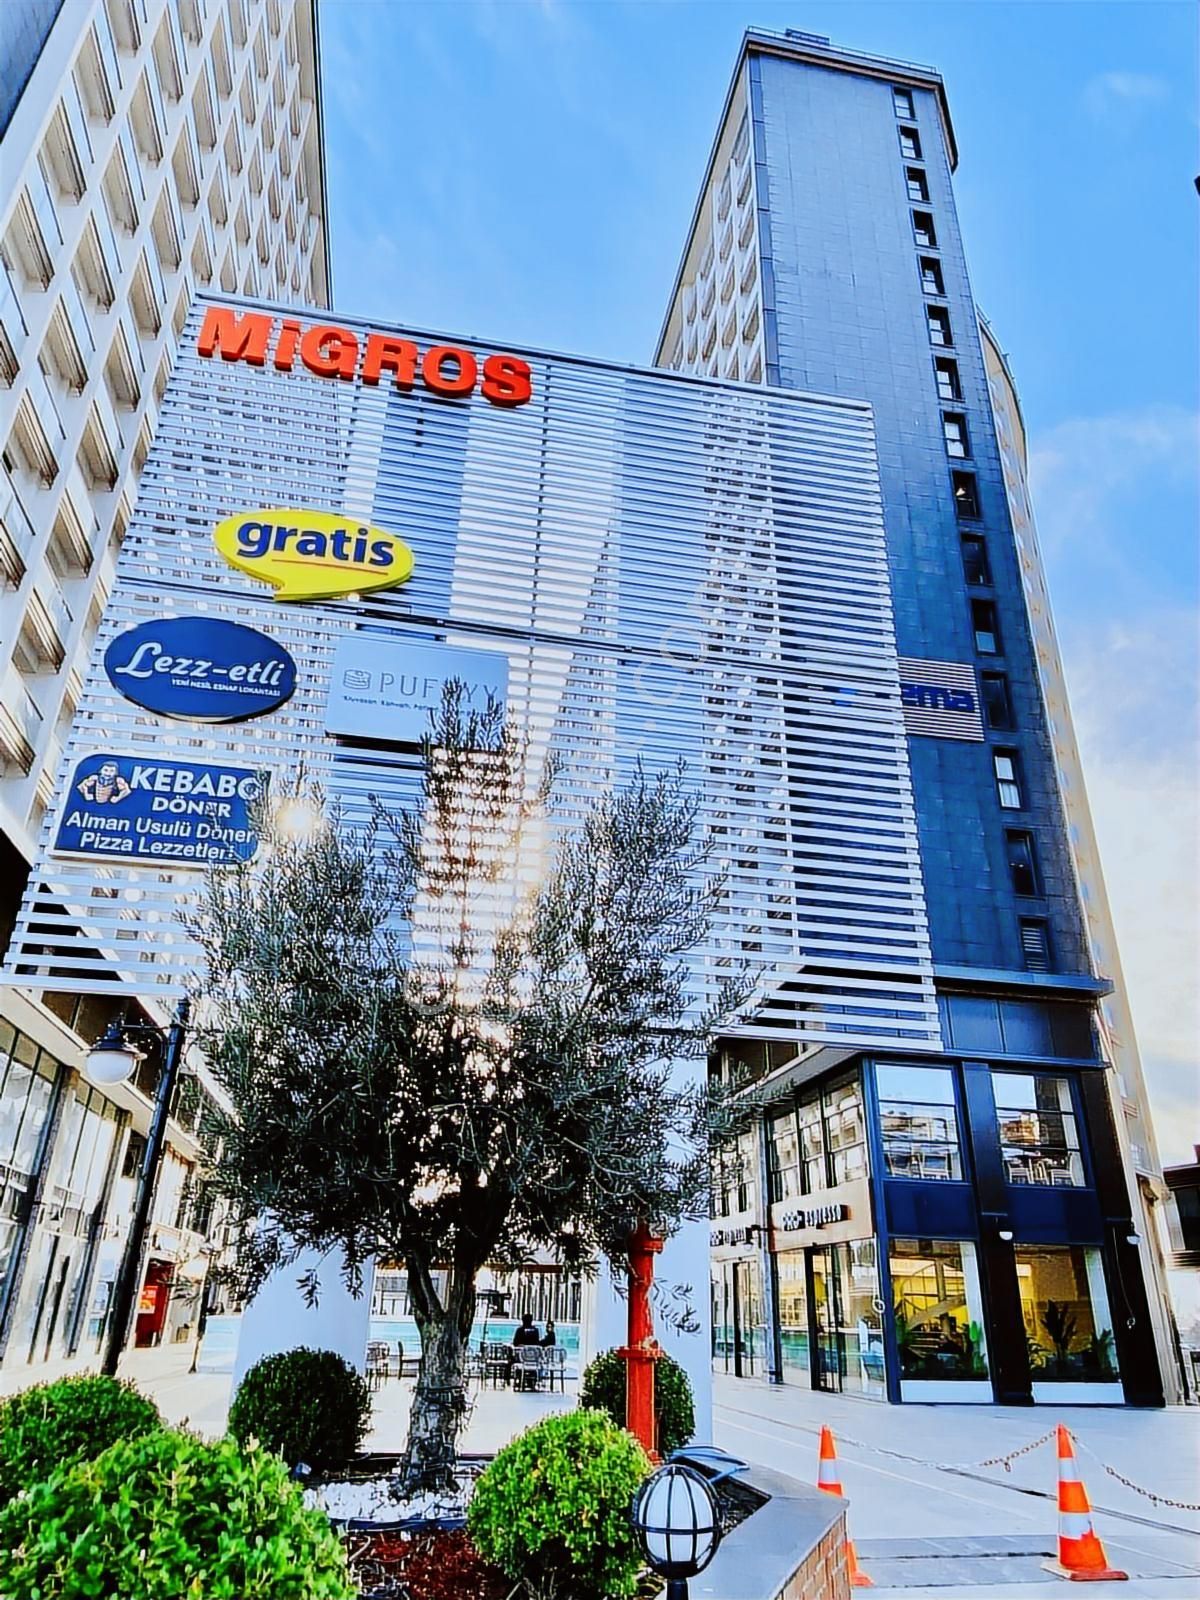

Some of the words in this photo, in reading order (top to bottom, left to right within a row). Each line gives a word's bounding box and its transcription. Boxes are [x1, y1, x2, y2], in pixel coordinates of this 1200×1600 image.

[236, 521, 395, 567] gratis
[115, 642, 285, 686] Lezz-etli
[65, 811, 131, 832] Alman
[136, 817, 192, 837] Usulü
[196, 823, 256, 844] Döner
[80, 832, 134, 854] Pizza
